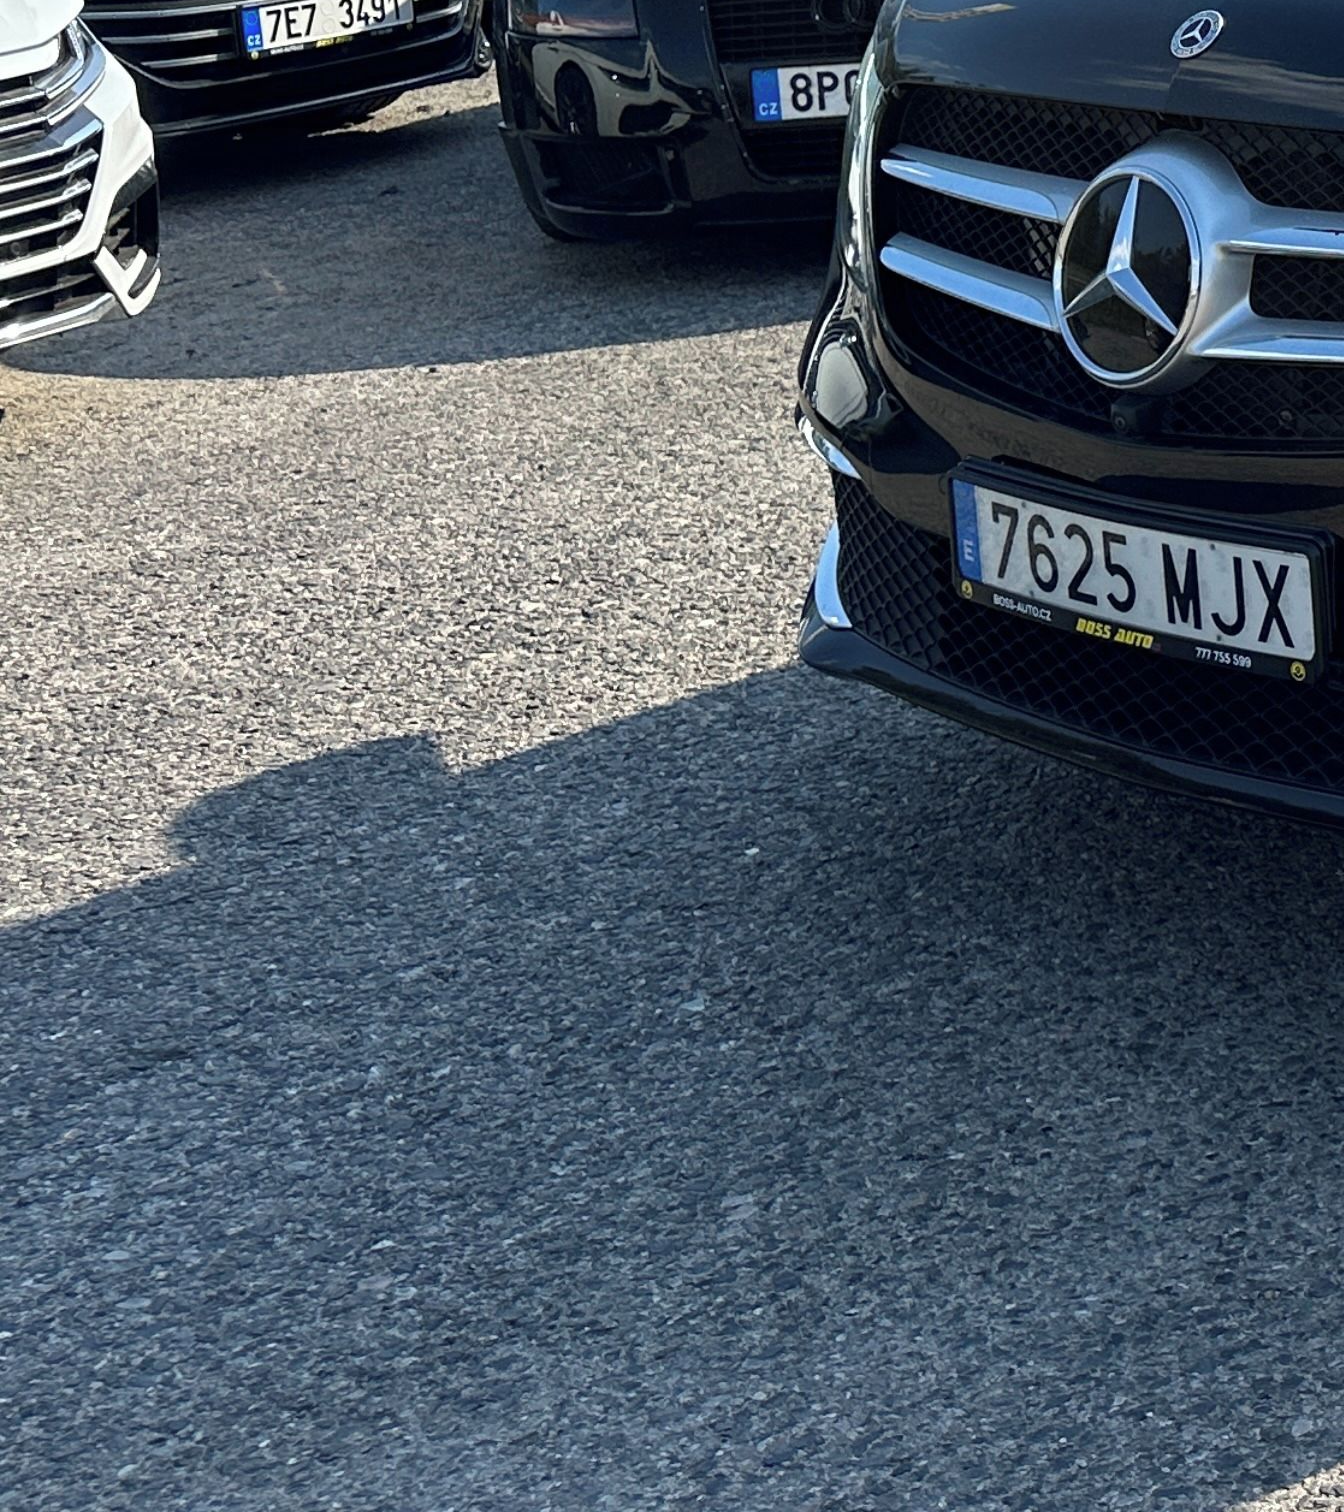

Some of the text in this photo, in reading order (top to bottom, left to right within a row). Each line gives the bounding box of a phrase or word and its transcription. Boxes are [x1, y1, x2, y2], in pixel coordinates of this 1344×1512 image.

[247, 34, 261, 47] CZ
[266, 3, 316, 43] 7E7
[759, 102, 778, 116] CZ
[963, 500, 1295, 649] E 7625 MJX
[1075, 617, 1112, 639] BOSS
[1114, 628, 1154, 649] AUTO
